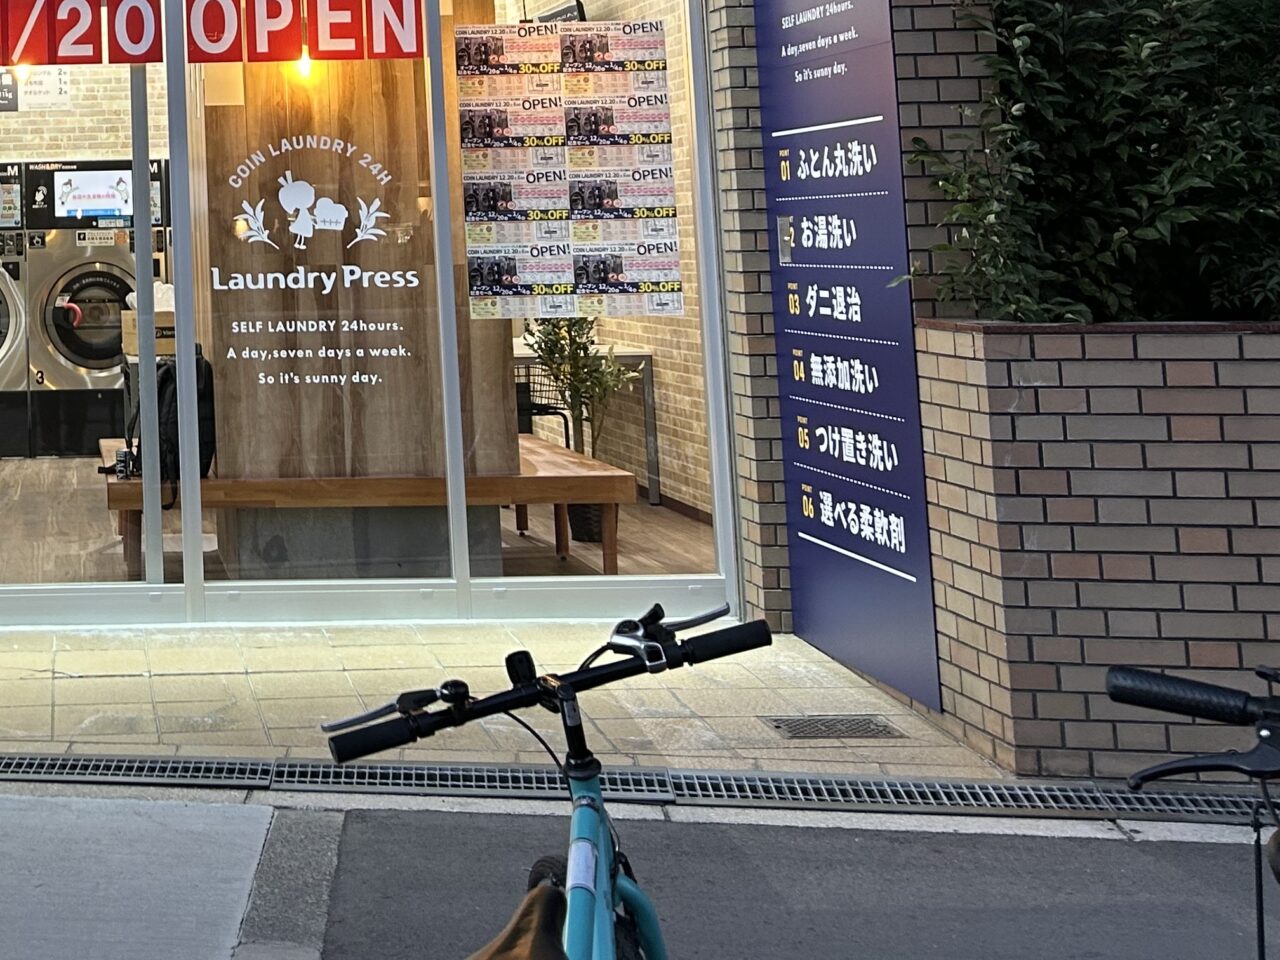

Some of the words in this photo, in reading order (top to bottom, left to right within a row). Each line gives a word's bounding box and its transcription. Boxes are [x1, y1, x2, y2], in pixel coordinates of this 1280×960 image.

[781, 14, 795, 29] SELF
[795, 5, 824, 25] LAUNDRY
[825, 0, 854, 16] 24hours.
[517, 25, 557, 38] OPEN!
[623, 22, 663, 35] OPEN!
[781, 45, 787, 58] A
[817, 35, 833, 49] days
[833, 34, 838, 43] a
[838, 26, 859, 41] week.
[795, 70, 803, 82] So
[803, 68, 813, 81] it's
[813, 66, 832, 79] sunny
[833, 61, 848, 75] day.
[521, 96, 561, 110] OPEN!
[628, 94, 668, 108] OPEN!
[228, 150, 266, 189] COIN
[268, 135, 357, 158] LAUNDRY
[358, 153, 393, 187] 24H
[780, 160, 791, 182] 01
[796, 140, 878, 180] ふとん丸洗い
[7, 165, 19, 176] M
[526, 169, 565, 184] OPEN!
[632, 167, 672, 181] OPEN!
[800, 214, 857, 250] お湯洗い
[530, 243, 570, 258] OPEN!
[637, 241, 678, 255] OPEN!
[210, 265, 337, 295] Laundry
[341, 265, 419, 289] Press
[788, 293, 800, 315] 03
[806, 283, 862, 322] ダニ退治
[231, 321, 263, 333] SELF
[268, 320, 336, 333] LAUNDRY
[341, 319, 404, 332] 24hours.
[226, 347, 237, 359] A
[317, 346, 351, 360] days
[355, 348, 364, 358] a
[369, 345, 411, 357] week.
[35, 370, 45, 385] 3
[258, 372, 275, 384] So
[279, 372, 300, 384] it's
[305, 373, 346, 386] sunny
[351, 371, 383, 385] day.
[793, 360, 805, 382] 04
[810, 352, 879, 394] 無添加洗い
[798, 427, 810, 450] 05
[815, 425, 899, 471] つけ置き洗い
[802, 495, 815, 519] 06
[819, 491, 906, 554] 選べる柔軟剤
